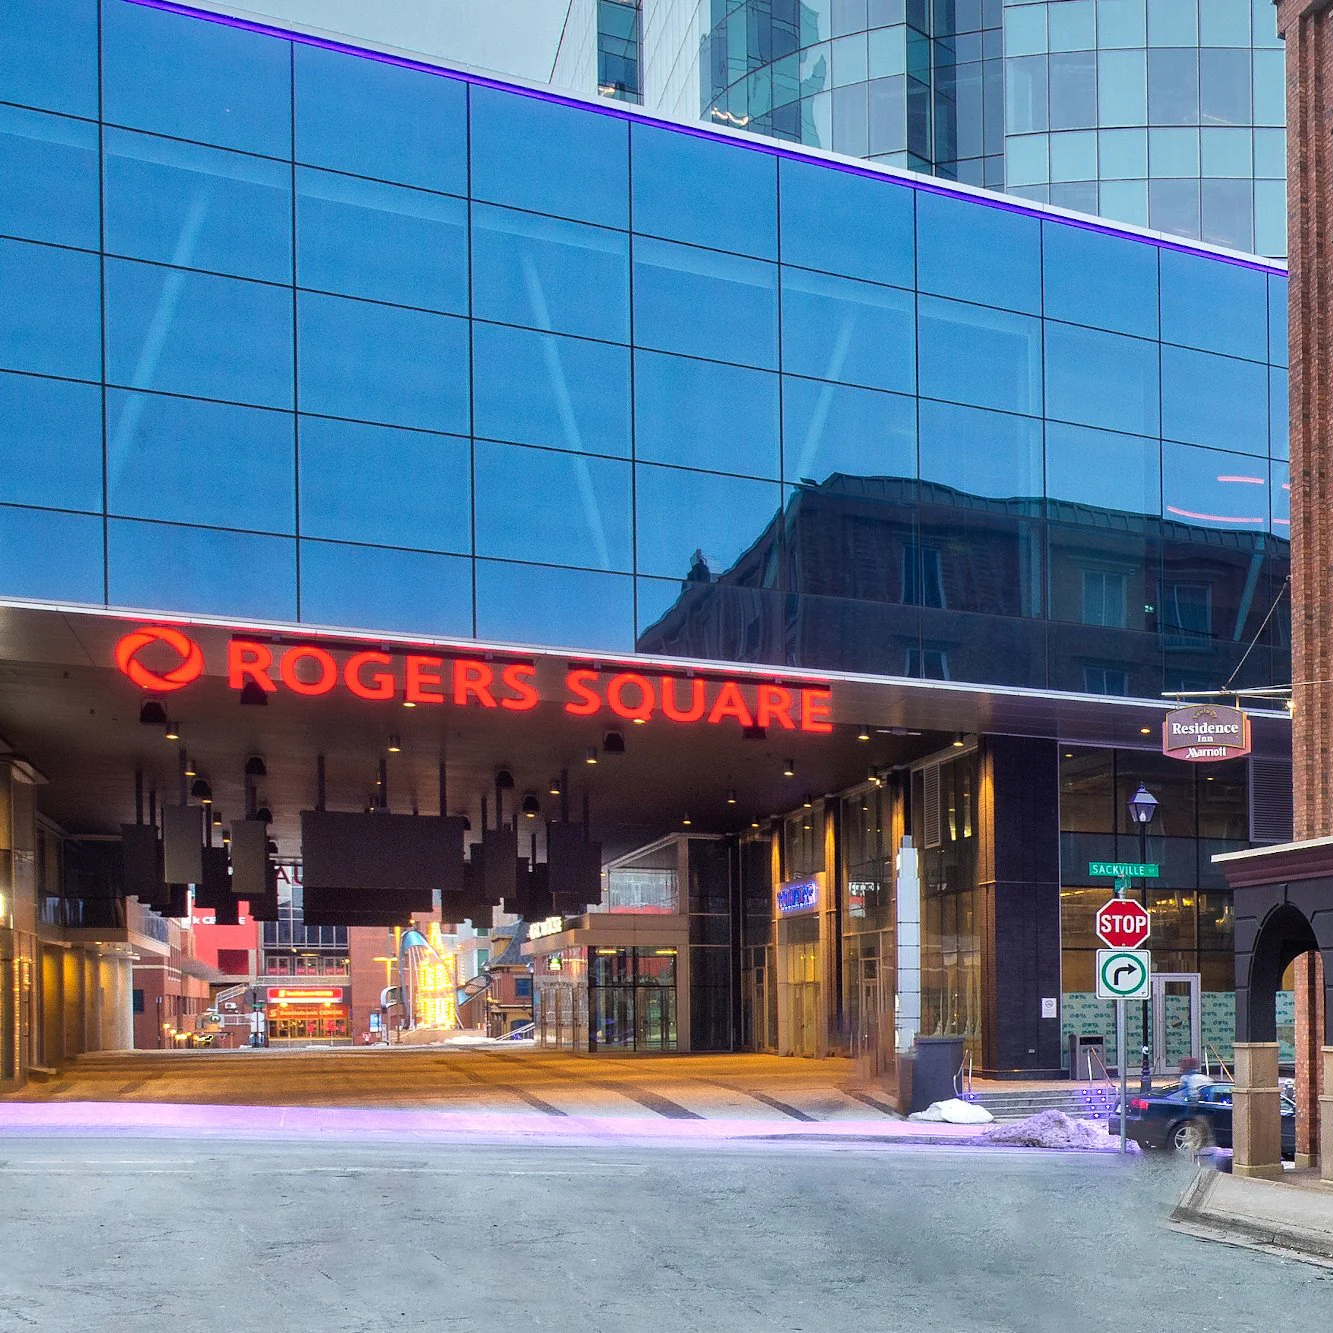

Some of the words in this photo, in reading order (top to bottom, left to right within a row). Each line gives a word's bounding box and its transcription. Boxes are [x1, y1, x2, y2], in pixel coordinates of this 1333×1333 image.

[228, 639, 540, 711] ROGERS
[564, 668, 833, 733] SQUARE
[1172, 722, 1239, 735] Residence
[1185, 747, 1227, 759] Marriott
[1092, 864, 1145, 875] SACKVILLE
[1101, 914, 1147, 934] STOP
